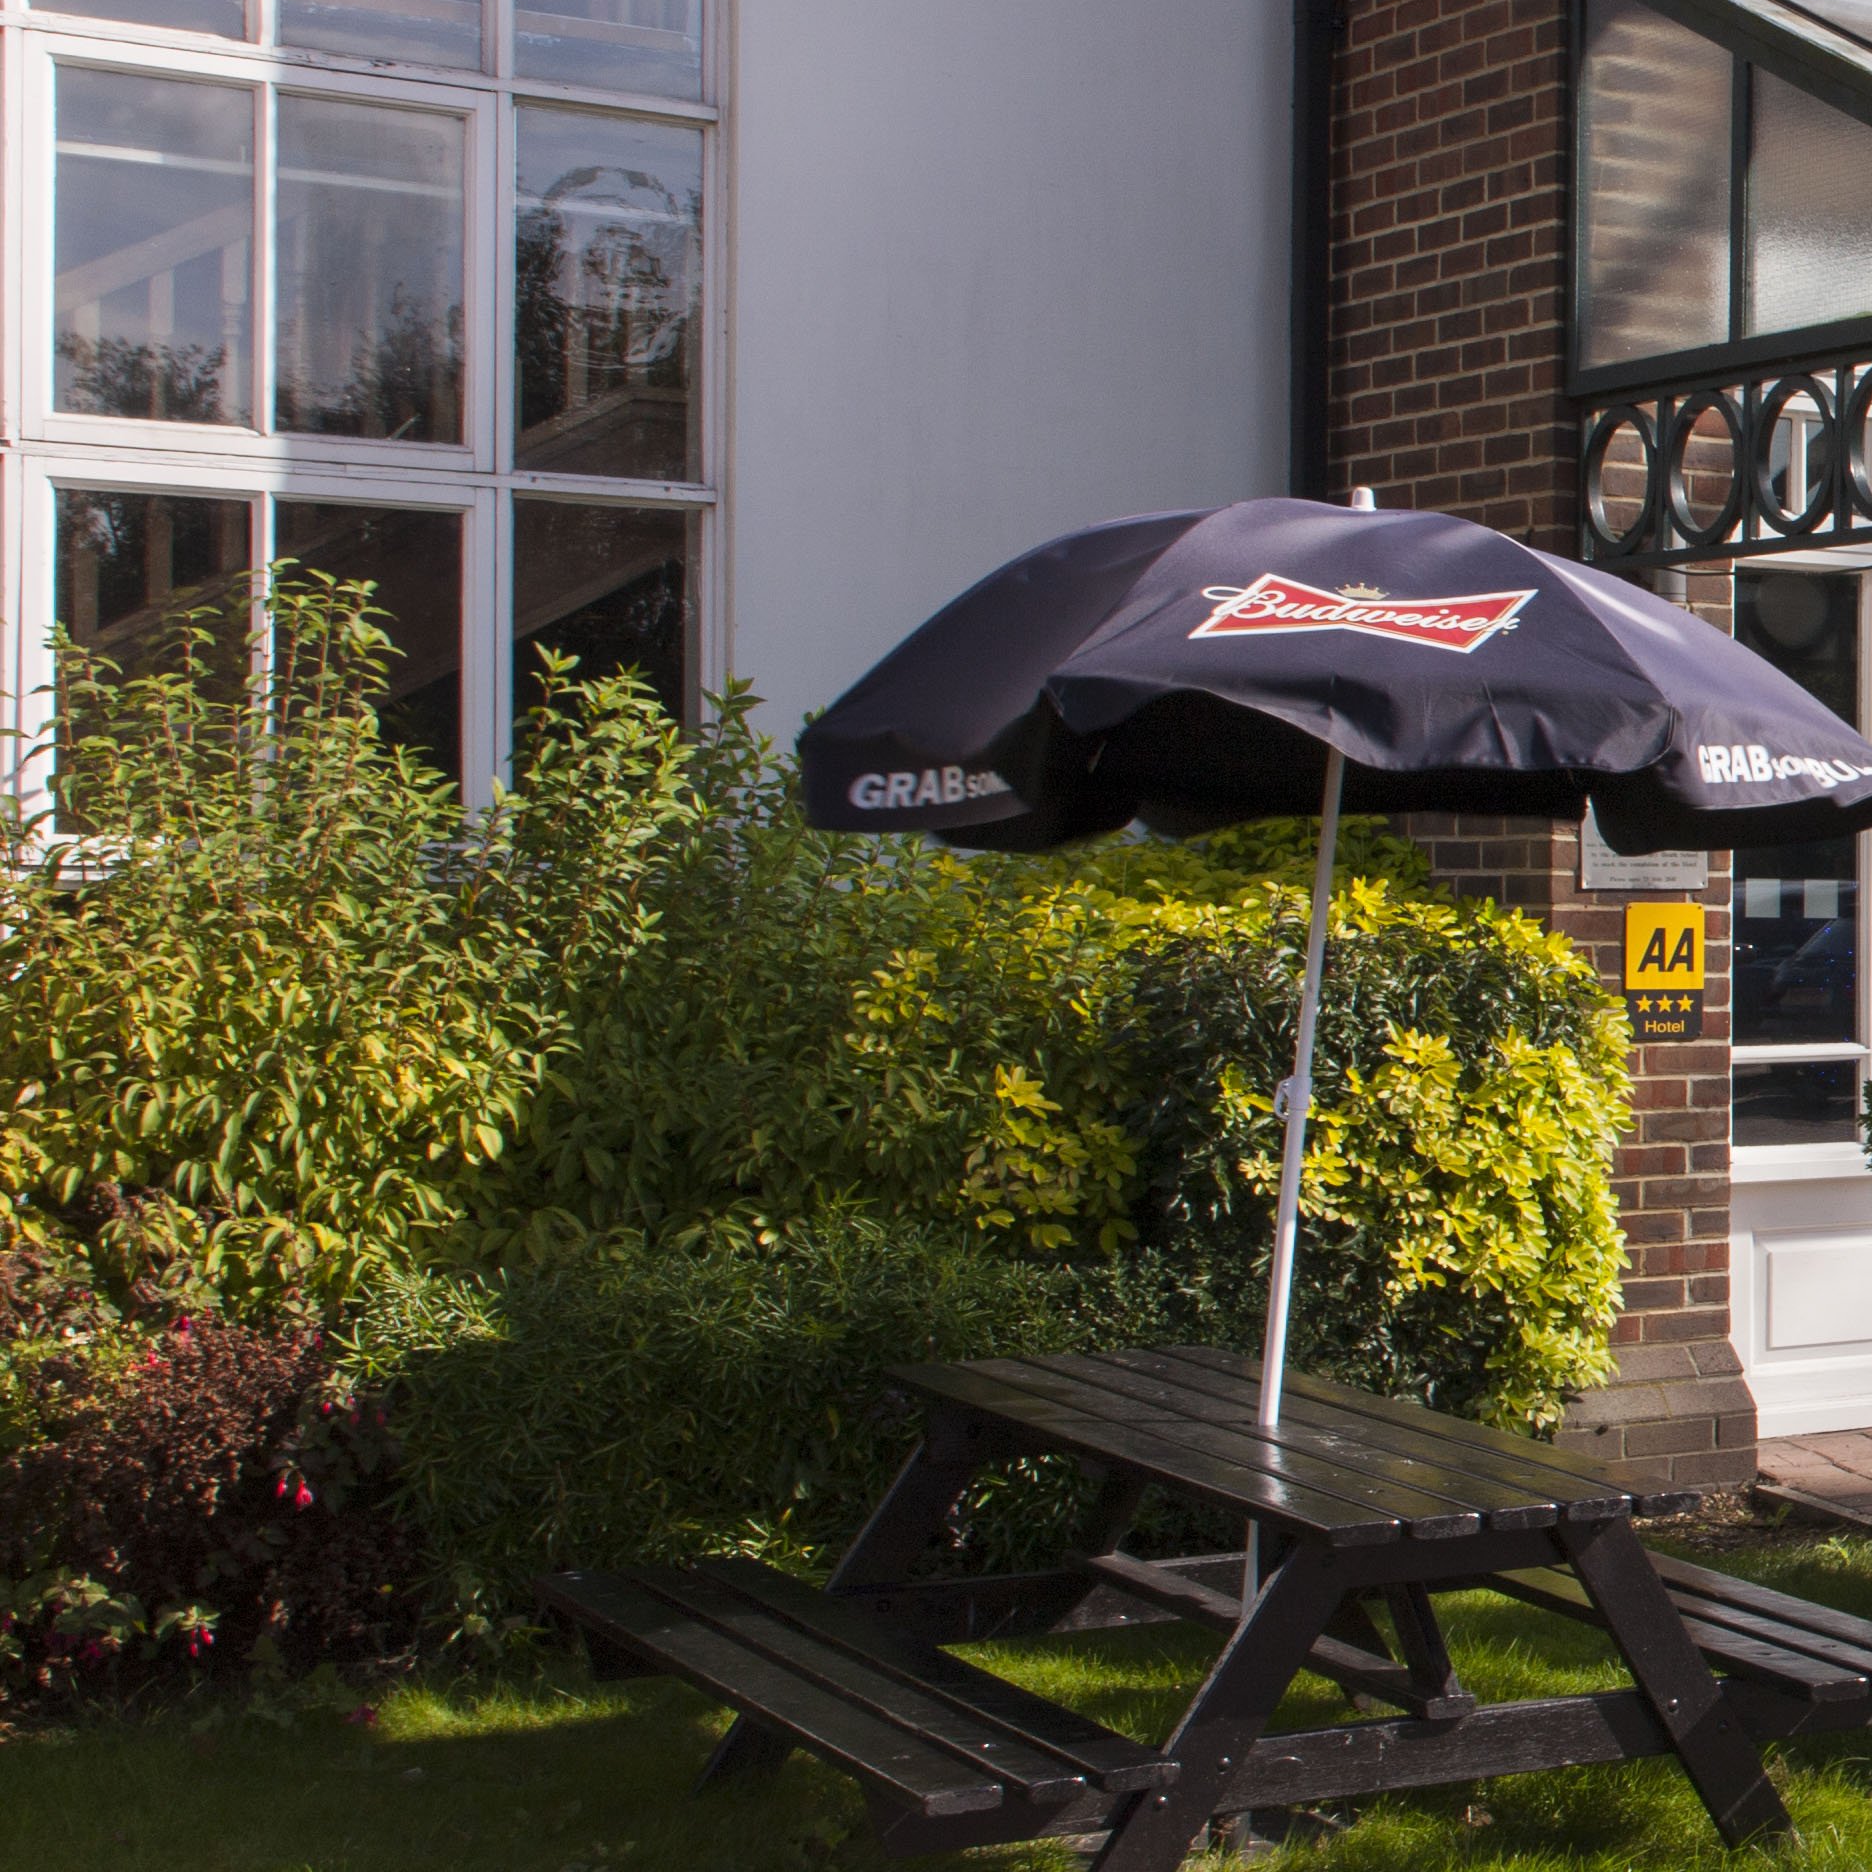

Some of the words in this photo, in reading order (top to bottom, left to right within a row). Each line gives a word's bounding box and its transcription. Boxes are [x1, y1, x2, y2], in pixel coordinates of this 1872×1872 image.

[1202, 585, 1520, 632] Budweiser
[1698, 744, 1774, 784] GRAB
[849, 765, 965, 810] GRAB
[1637, 927, 1695, 973] AA
[1644, 1019, 1686, 1033] Hotel
